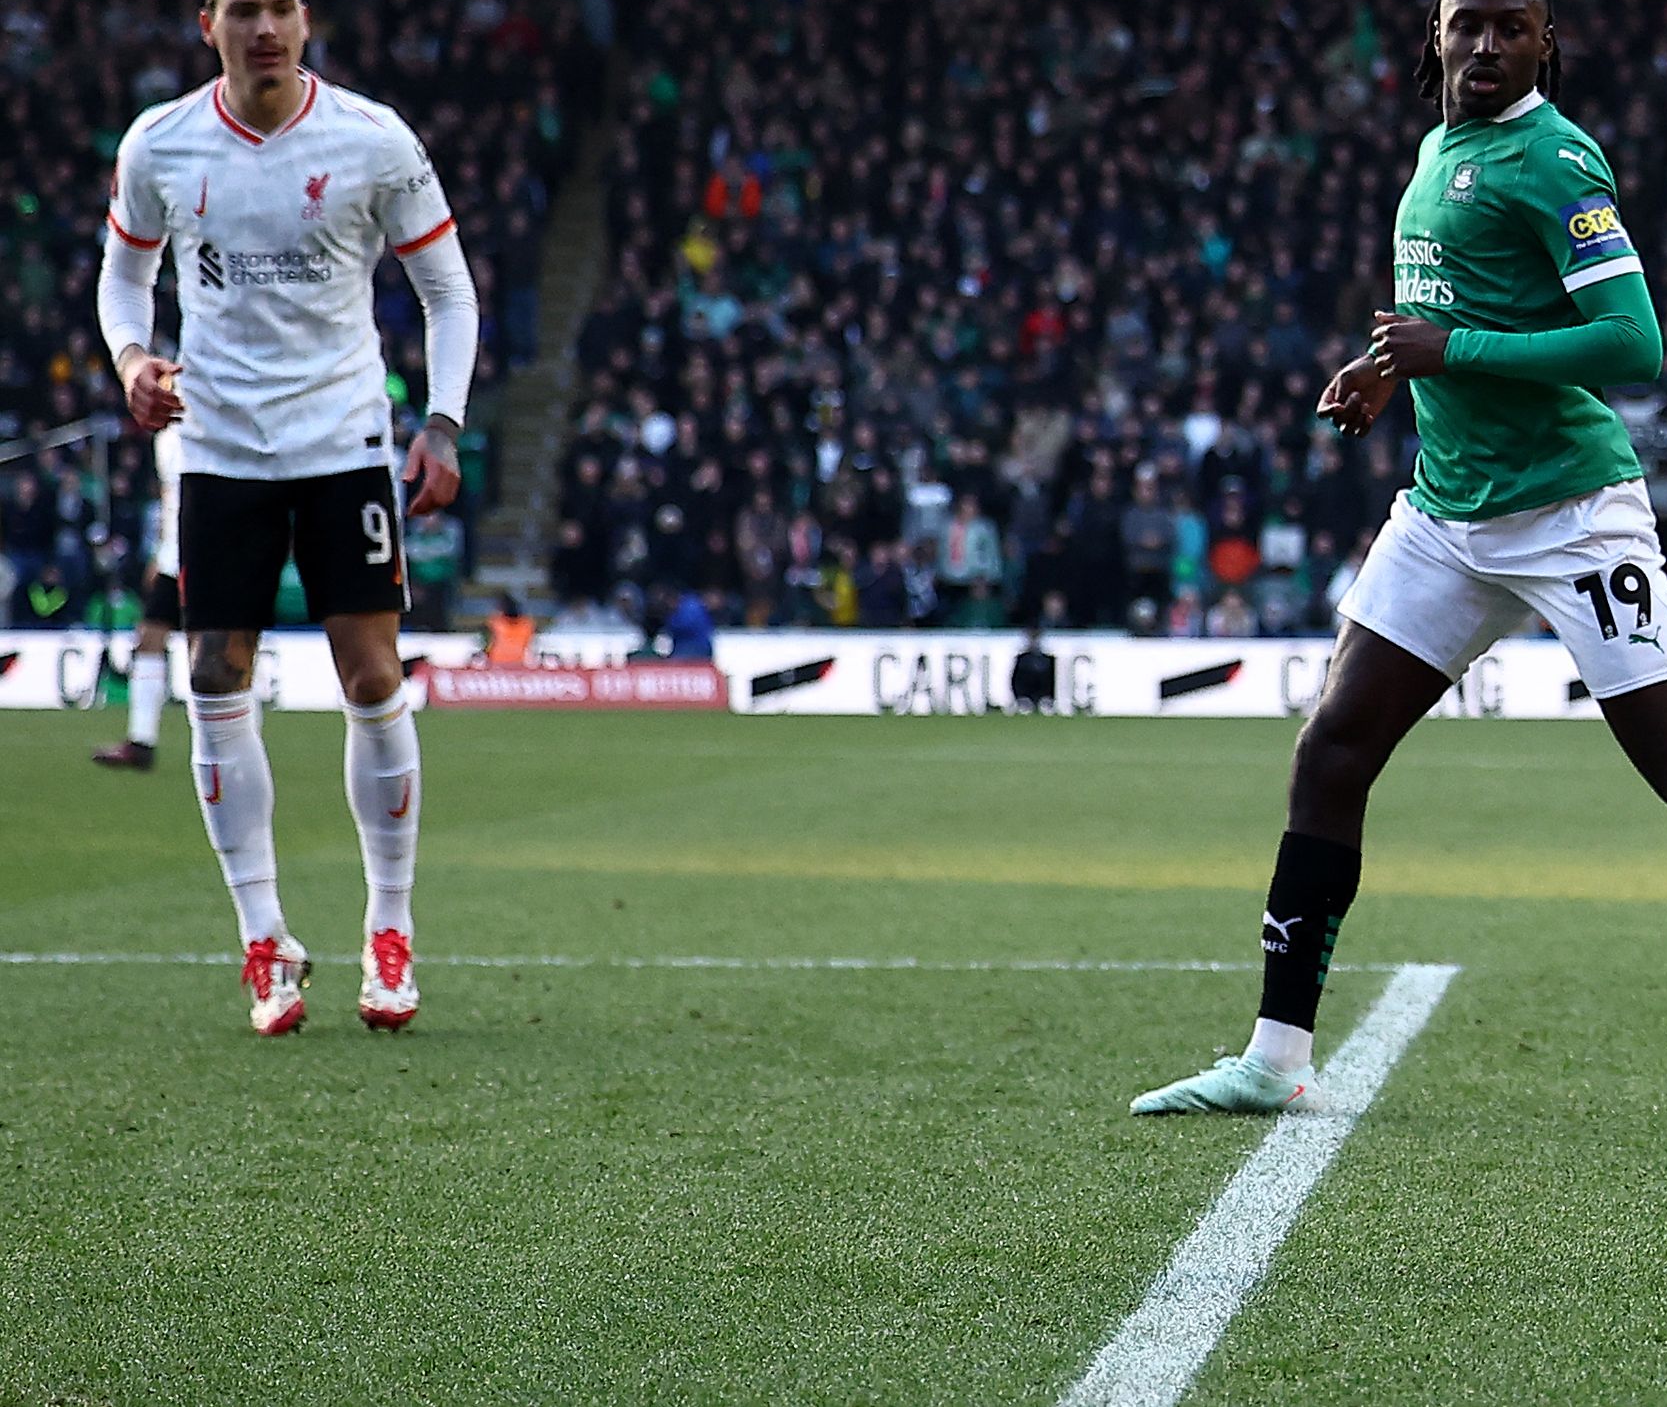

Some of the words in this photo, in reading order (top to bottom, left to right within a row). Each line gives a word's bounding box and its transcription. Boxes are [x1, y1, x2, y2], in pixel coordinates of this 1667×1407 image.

[1393, 229, 1443, 267] lassic
[1394, 268, 1455, 306] ilders
[361, 501, 392, 562] 9
[1572, 562, 1652, 642] 19
[873, 652, 1094, 715] CARLG
